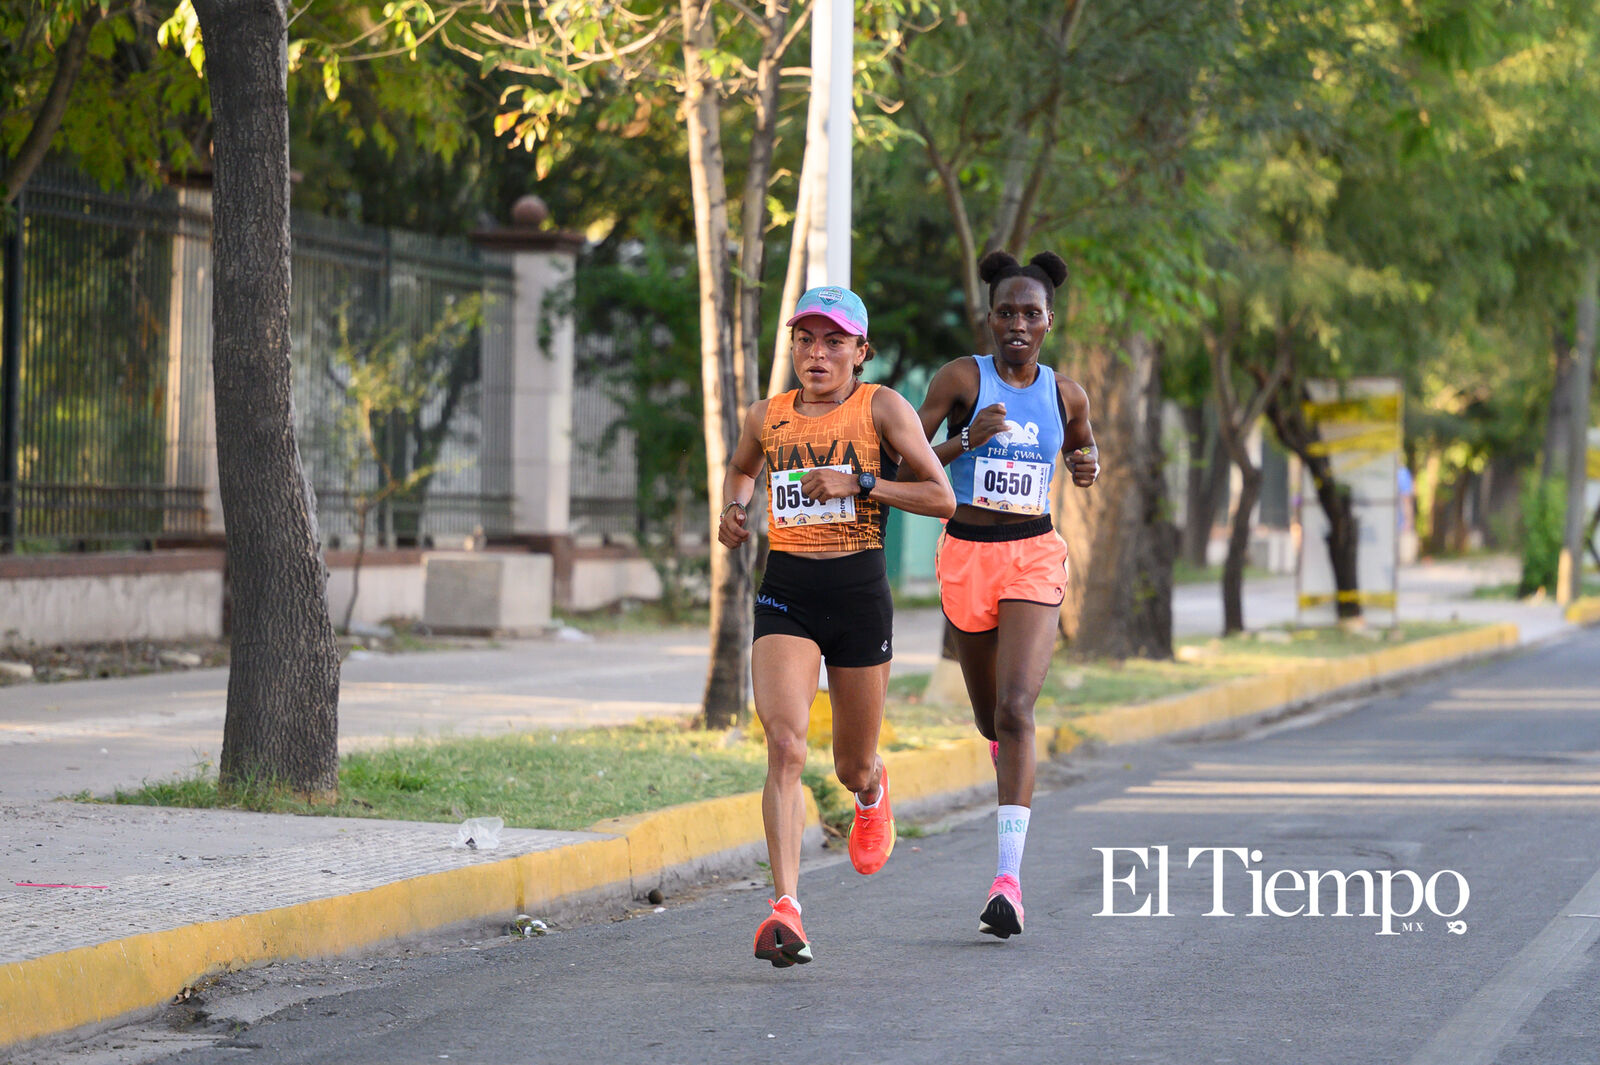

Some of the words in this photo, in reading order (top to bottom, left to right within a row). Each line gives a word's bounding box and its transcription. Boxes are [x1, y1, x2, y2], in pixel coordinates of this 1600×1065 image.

[987, 447, 1009, 457] THE
[1012, 450, 1043, 460] SWAN
[984, 470, 1032, 496] 0550
